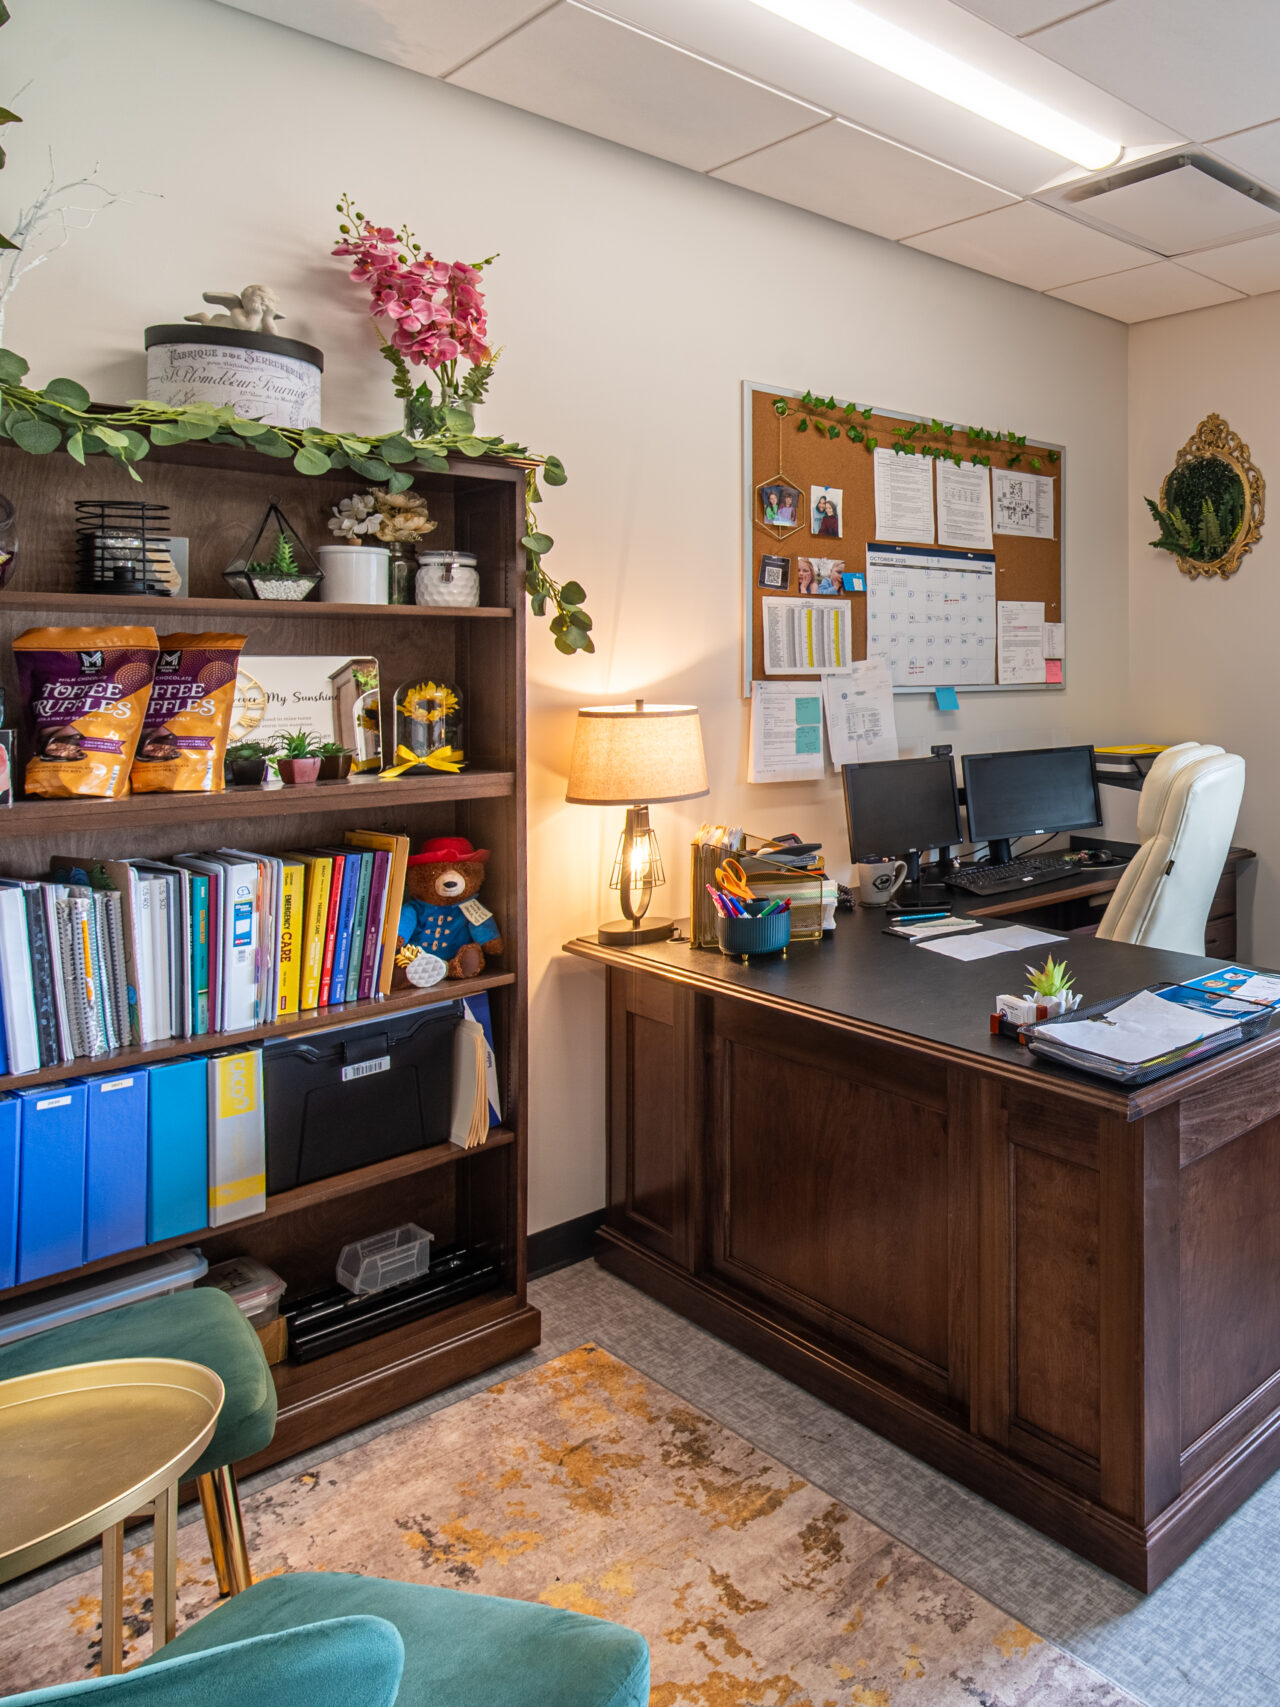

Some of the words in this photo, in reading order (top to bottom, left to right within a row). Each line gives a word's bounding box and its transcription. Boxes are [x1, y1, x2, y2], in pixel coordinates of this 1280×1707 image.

[42, 682, 123, 698] TOFFEE
[152, 683, 206, 698] FFEE
[264, 691, 287, 706] My
[32, 698, 132, 719] TRUFFLES
[148, 698, 216, 716] FFLES
[283, 894, 292, 930] EMERGENCY
[280, 932, 293, 963] CARE
